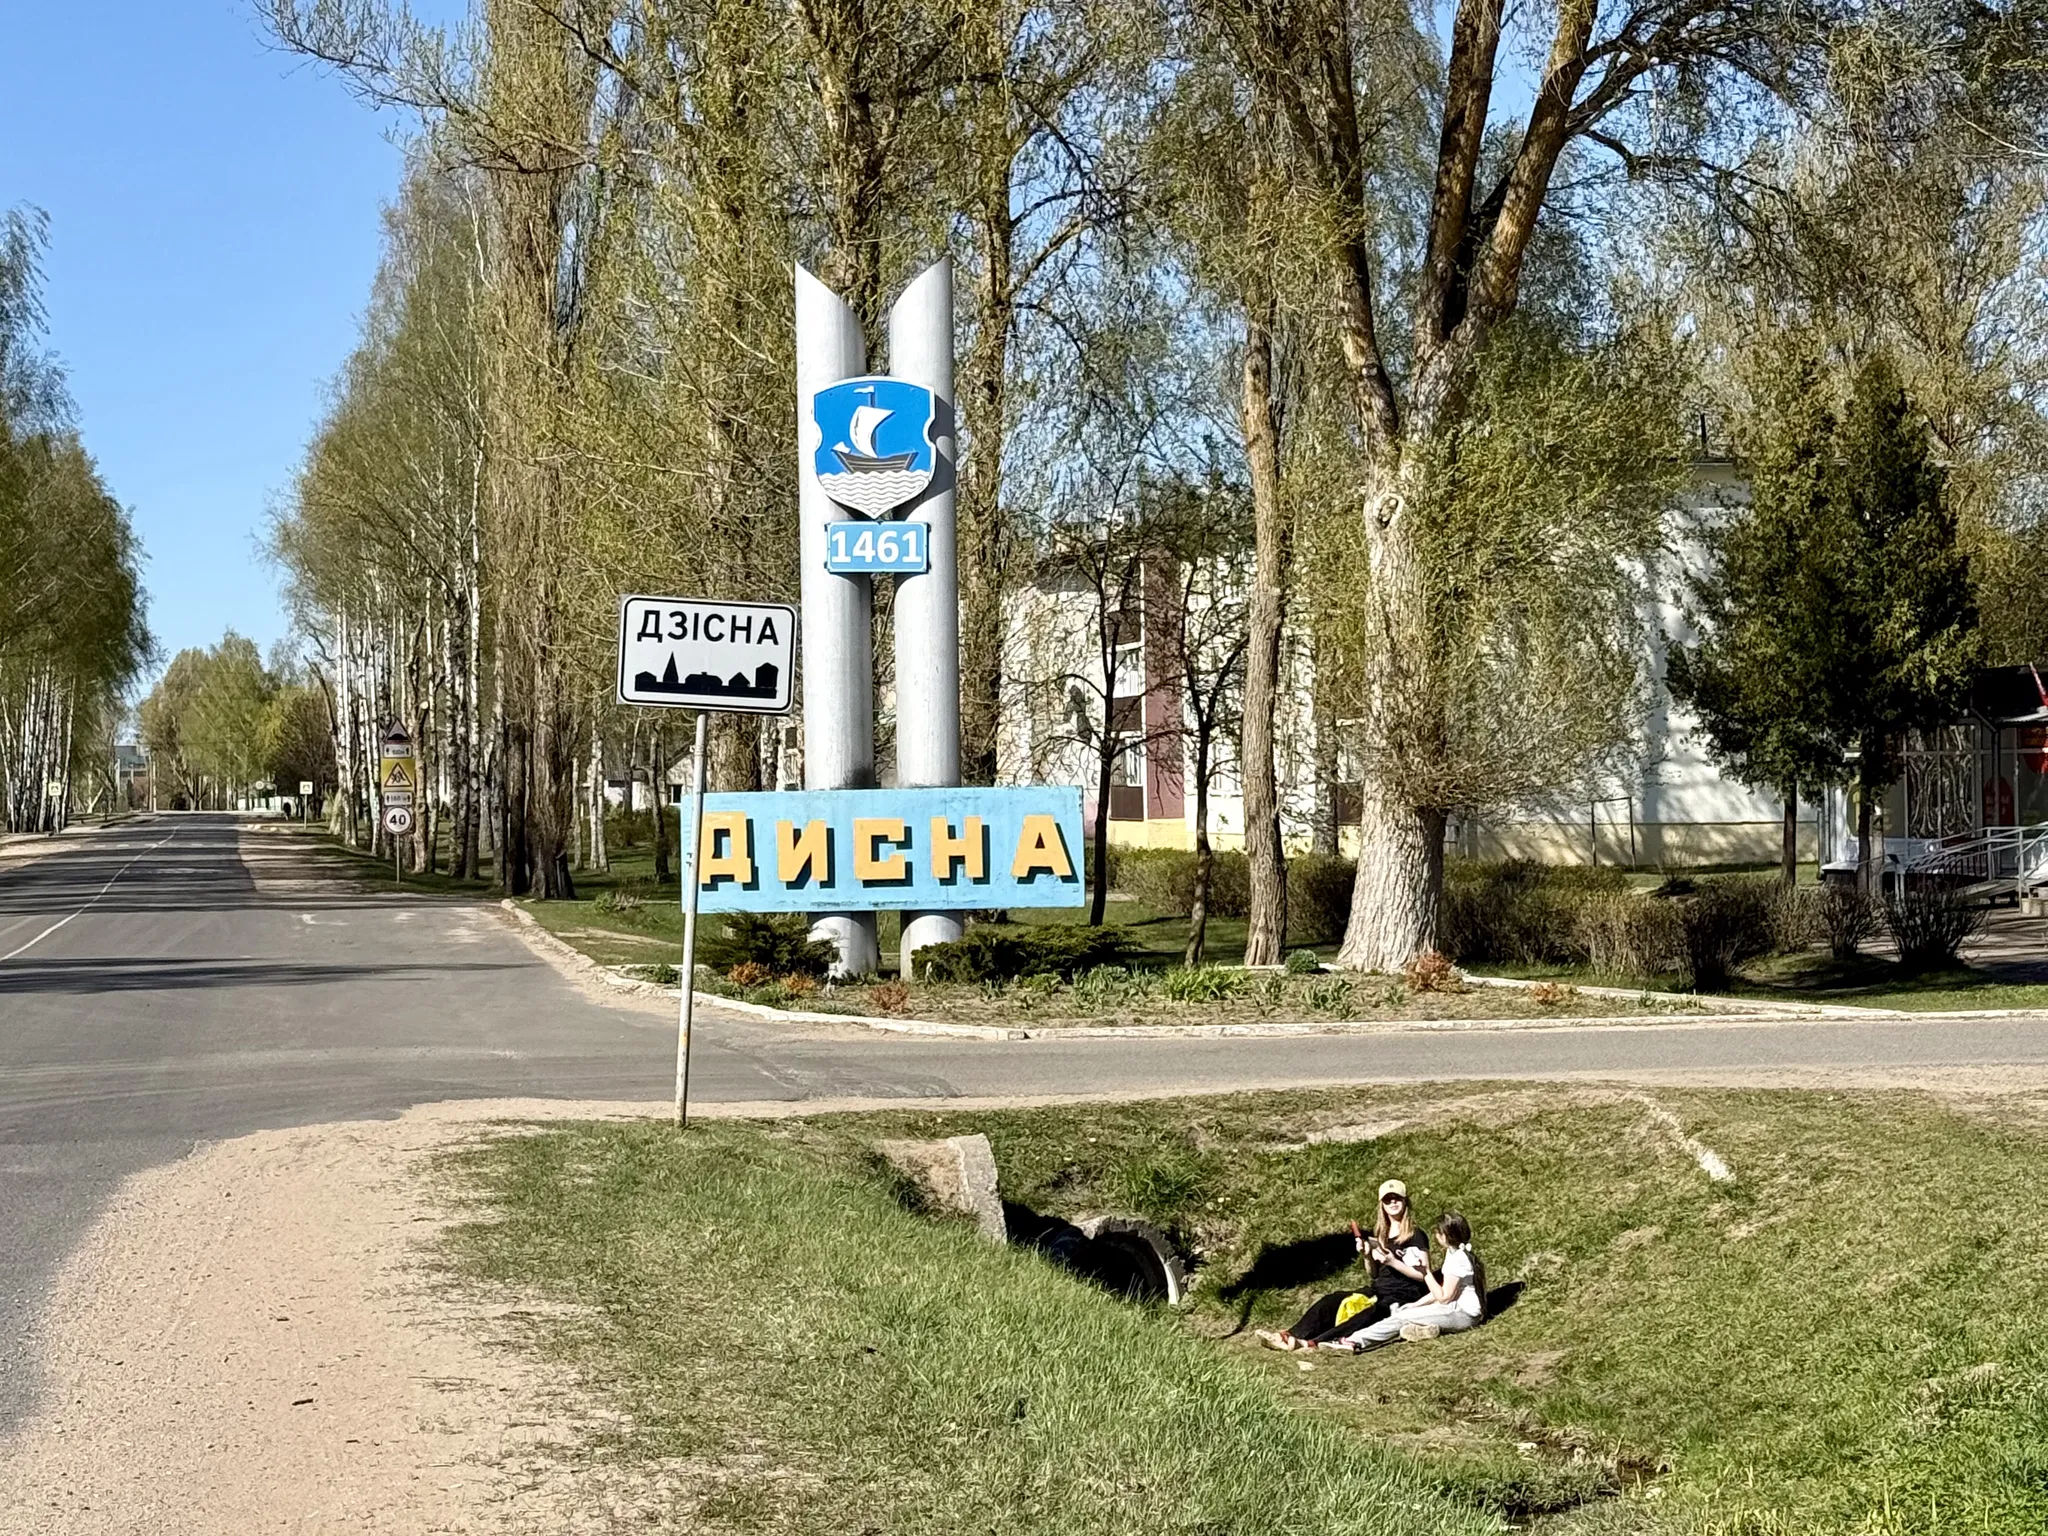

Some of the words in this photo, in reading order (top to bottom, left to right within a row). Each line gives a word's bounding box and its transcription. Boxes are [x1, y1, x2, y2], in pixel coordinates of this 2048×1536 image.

[831, 530, 922, 563] 1461
[636, 609, 780, 646] ДЗІСНА
[390, 815, 406, 825] 40
[698, 810, 1075, 887] ДИСНА
